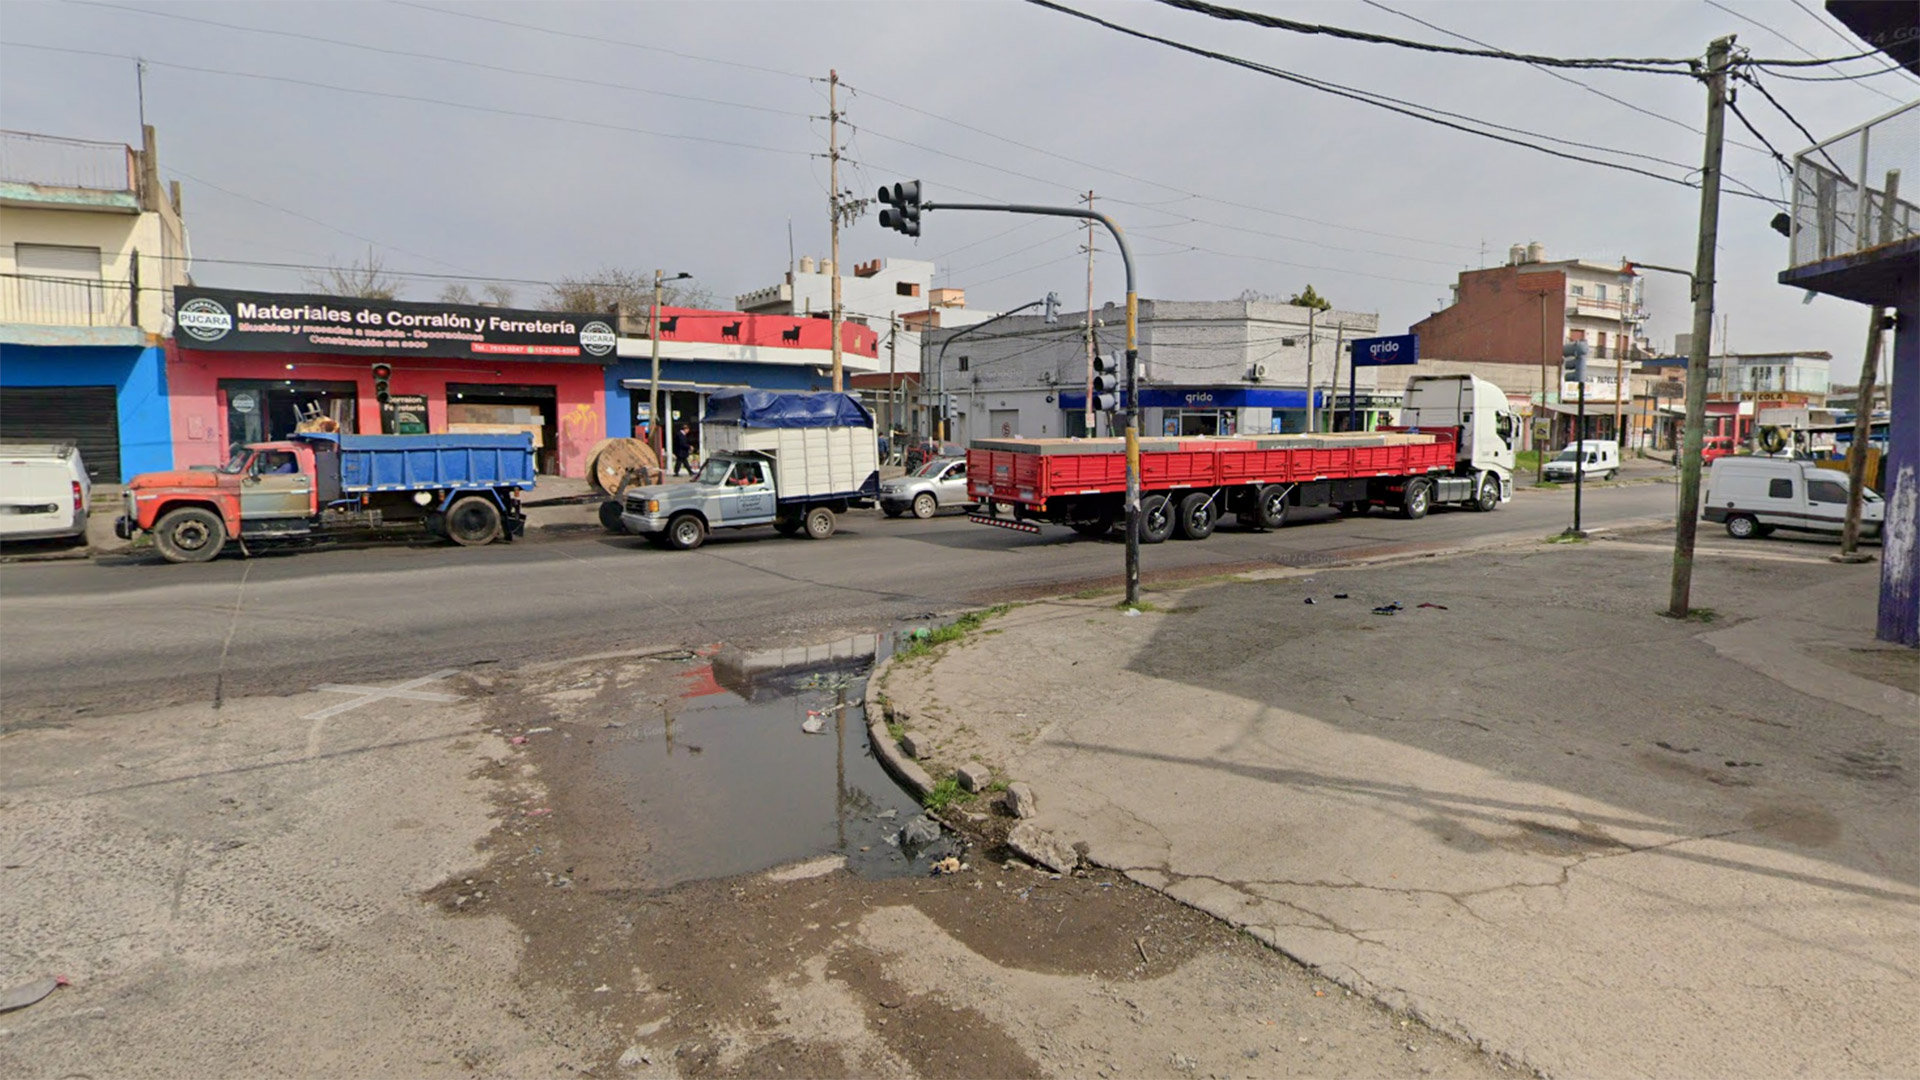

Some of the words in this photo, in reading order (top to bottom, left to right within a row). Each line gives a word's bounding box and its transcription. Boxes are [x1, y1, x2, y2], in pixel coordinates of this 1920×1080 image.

[180, 314, 230, 325] PUCARA
[237, 302, 352, 322] Materiales
[356, 309, 382, 324] de
[387, 311, 471, 328] Corralón
[474, 318, 485, 332] y
[489, 317, 575, 334] Ferretería
[238, 322, 291, 332] Muebles
[292, 325, 301, 334] y
[302, 325, 354, 335] mesadas
[355, 328, 363, 336] a
[364, 328, 406, 338] medida
[413, 330, 484, 341] Decoraciones
[581, 334, 614, 342] PUCARA
[309, 334, 384, 347] Construcción
[385, 340, 400, 348] en
[401, 340, 428, 348] seco
[1369, 340, 1399, 356] grido
[1185, 391, 1213, 404] grido
